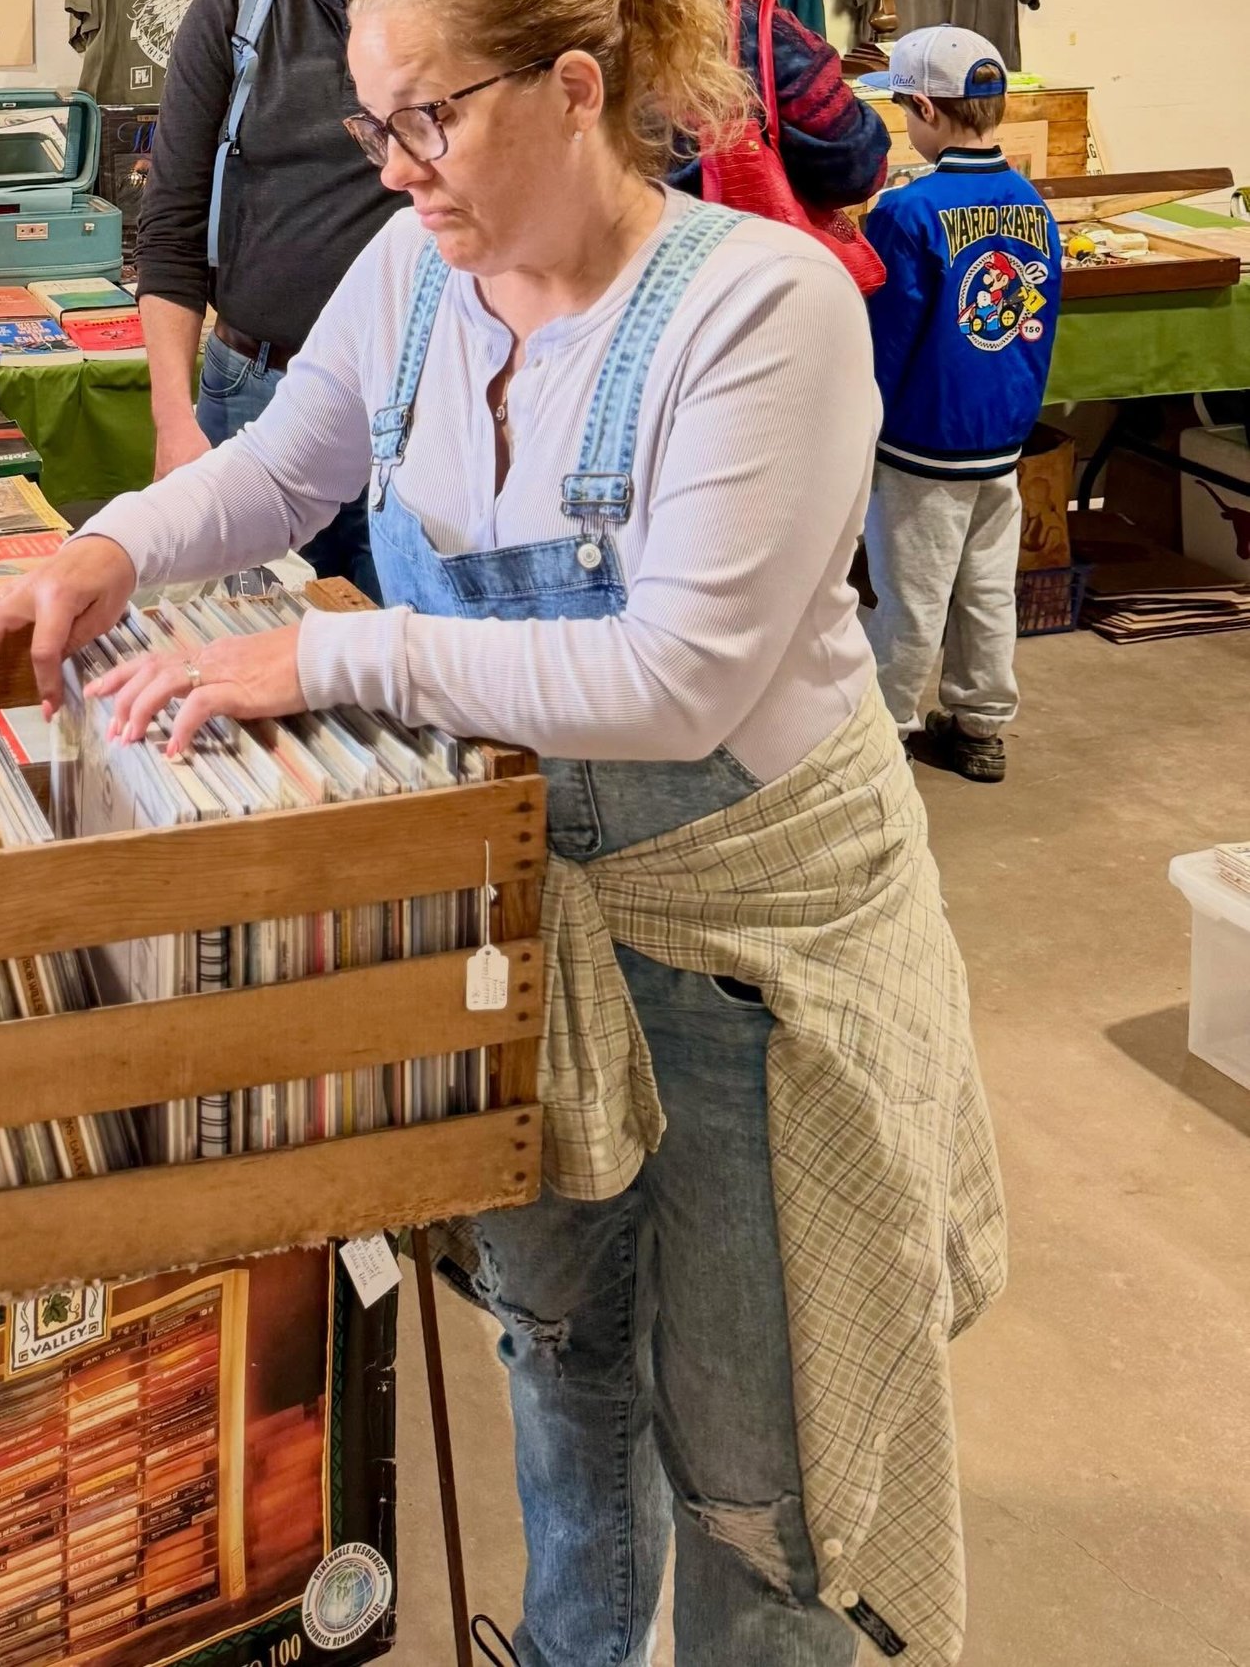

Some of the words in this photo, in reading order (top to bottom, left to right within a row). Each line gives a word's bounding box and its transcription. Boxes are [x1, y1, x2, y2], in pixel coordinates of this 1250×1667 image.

[938, 205, 998, 268] MARIO
[1000, 205, 1050, 259] KART
[1025, 263, 1046, 281] 07
[22, 956, 35, 985] BOB
[28, 983, 44, 1011] WILLS
[30, 1324, 87, 1356] VALLEY
[313, 1544, 350, 1581] RENEWABLE
[352, 1543, 389, 1576] RESOURCES
[304, 1611, 331, 1646] RESOURCES
[332, 1602, 383, 1647] RENOUVELABLES
[269, 1633, 301, 1664] 100
